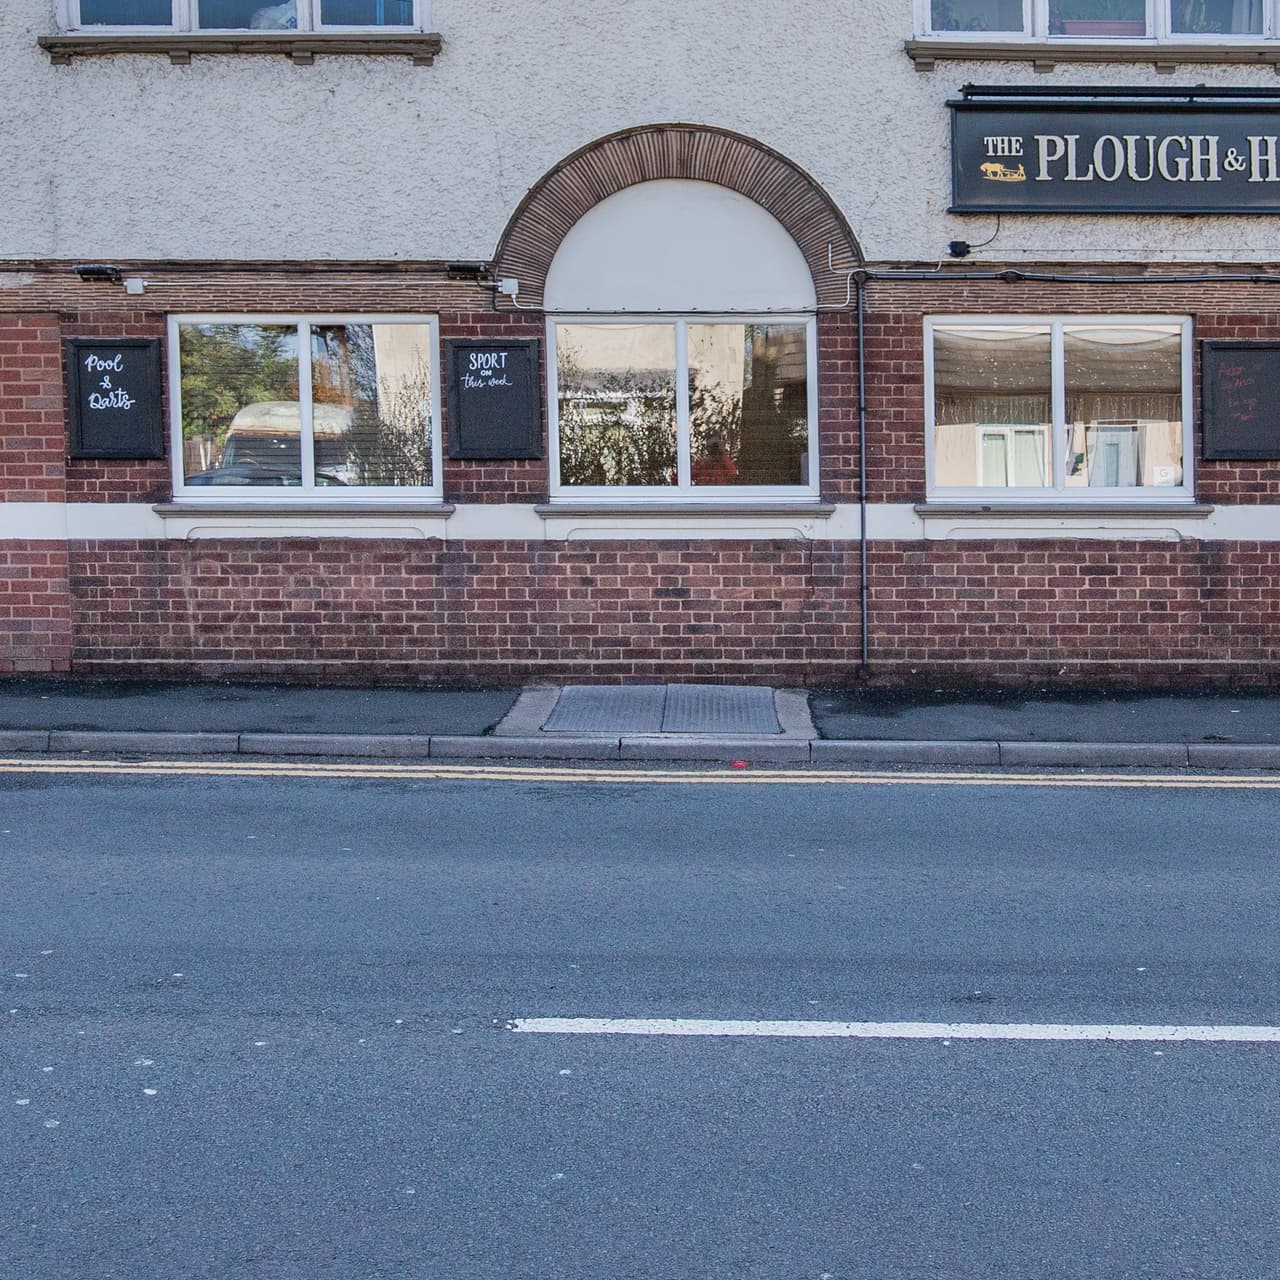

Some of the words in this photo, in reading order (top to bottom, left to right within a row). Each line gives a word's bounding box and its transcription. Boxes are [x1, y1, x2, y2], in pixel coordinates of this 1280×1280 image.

[984, 136, 1023, 156] THE
[1033, 135, 1222, 182] PLOUGH
[1223, 147, 1247, 171] &
[85, 353, 123, 372] Pool
[469, 352, 508, 370] SPORT
[100, 375, 112, 389] &
[461, 373, 486, 388] this
[88, 387, 135, 409] Darts
